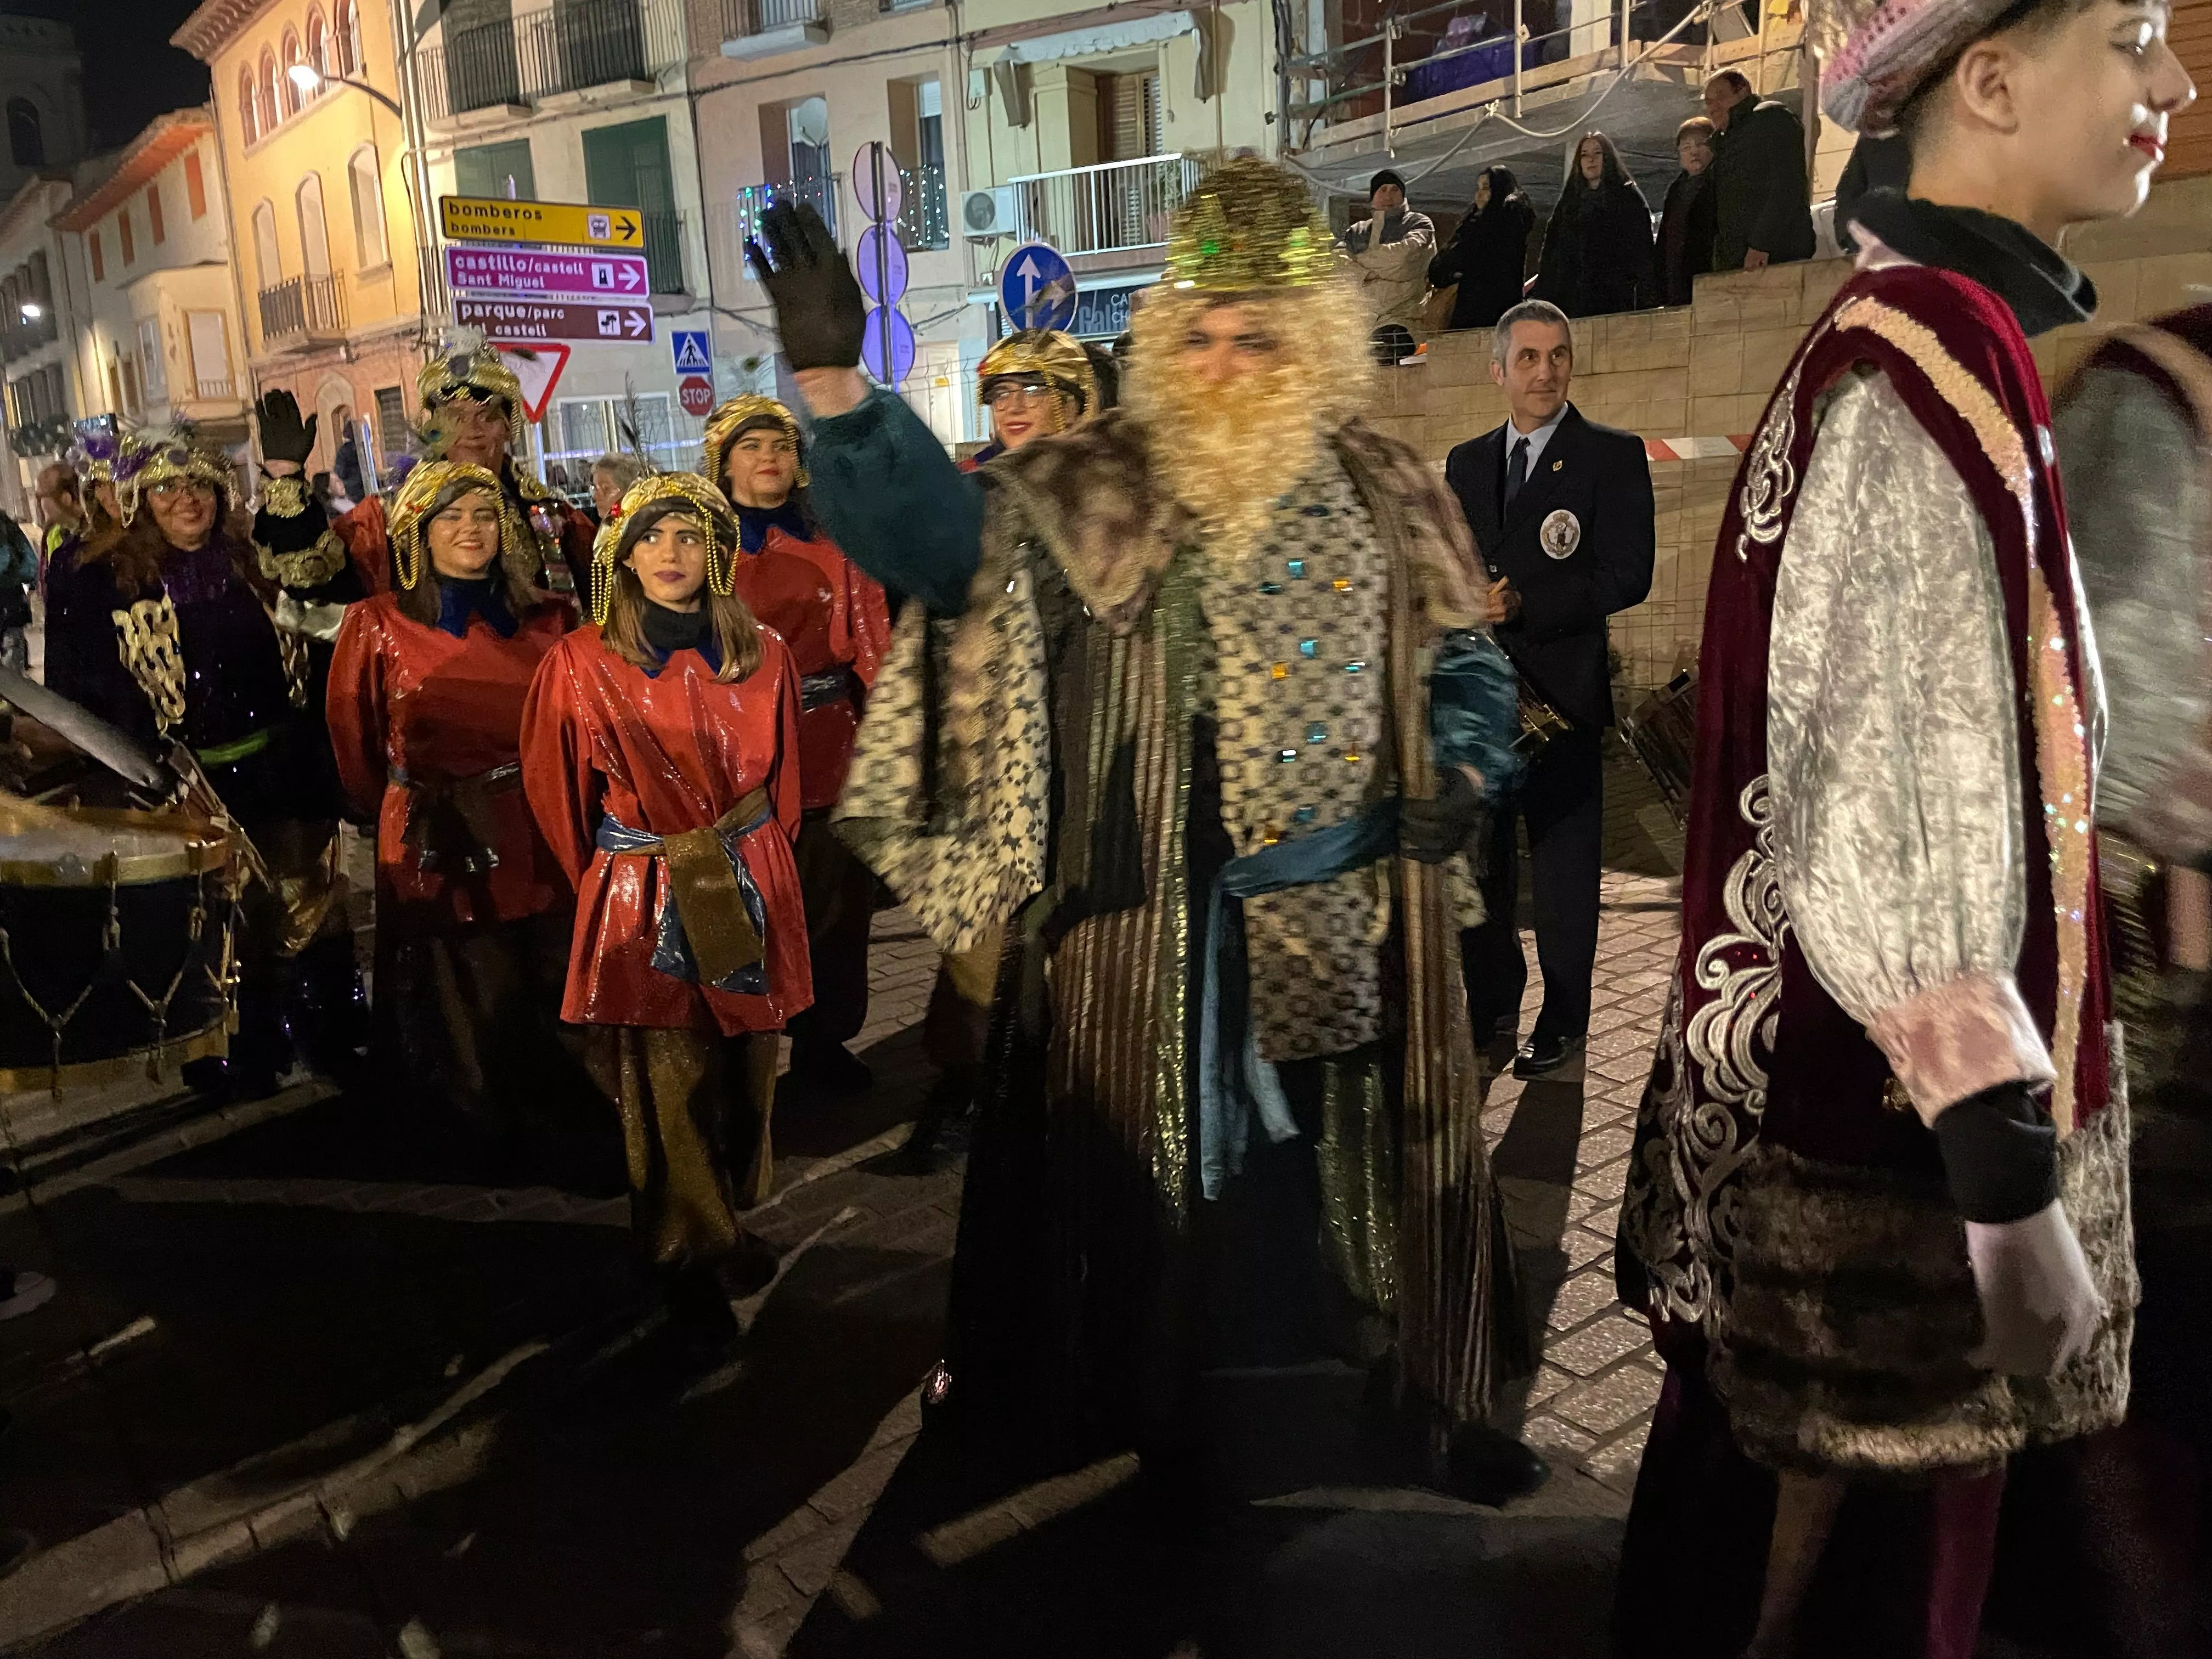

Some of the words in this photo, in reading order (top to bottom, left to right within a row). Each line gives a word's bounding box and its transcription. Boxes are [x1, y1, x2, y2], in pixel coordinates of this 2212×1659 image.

[449, 200, 543, 221] bomberos
[451, 221, 516, 236] bombers
[457, 270, 492, 286] Sant
[498, 273, 545, 290] Miguel
[1110, 293, 1129, 306] CA
[495, 323, 546, 337] castell
[682, 388, 711, 405] STOP
